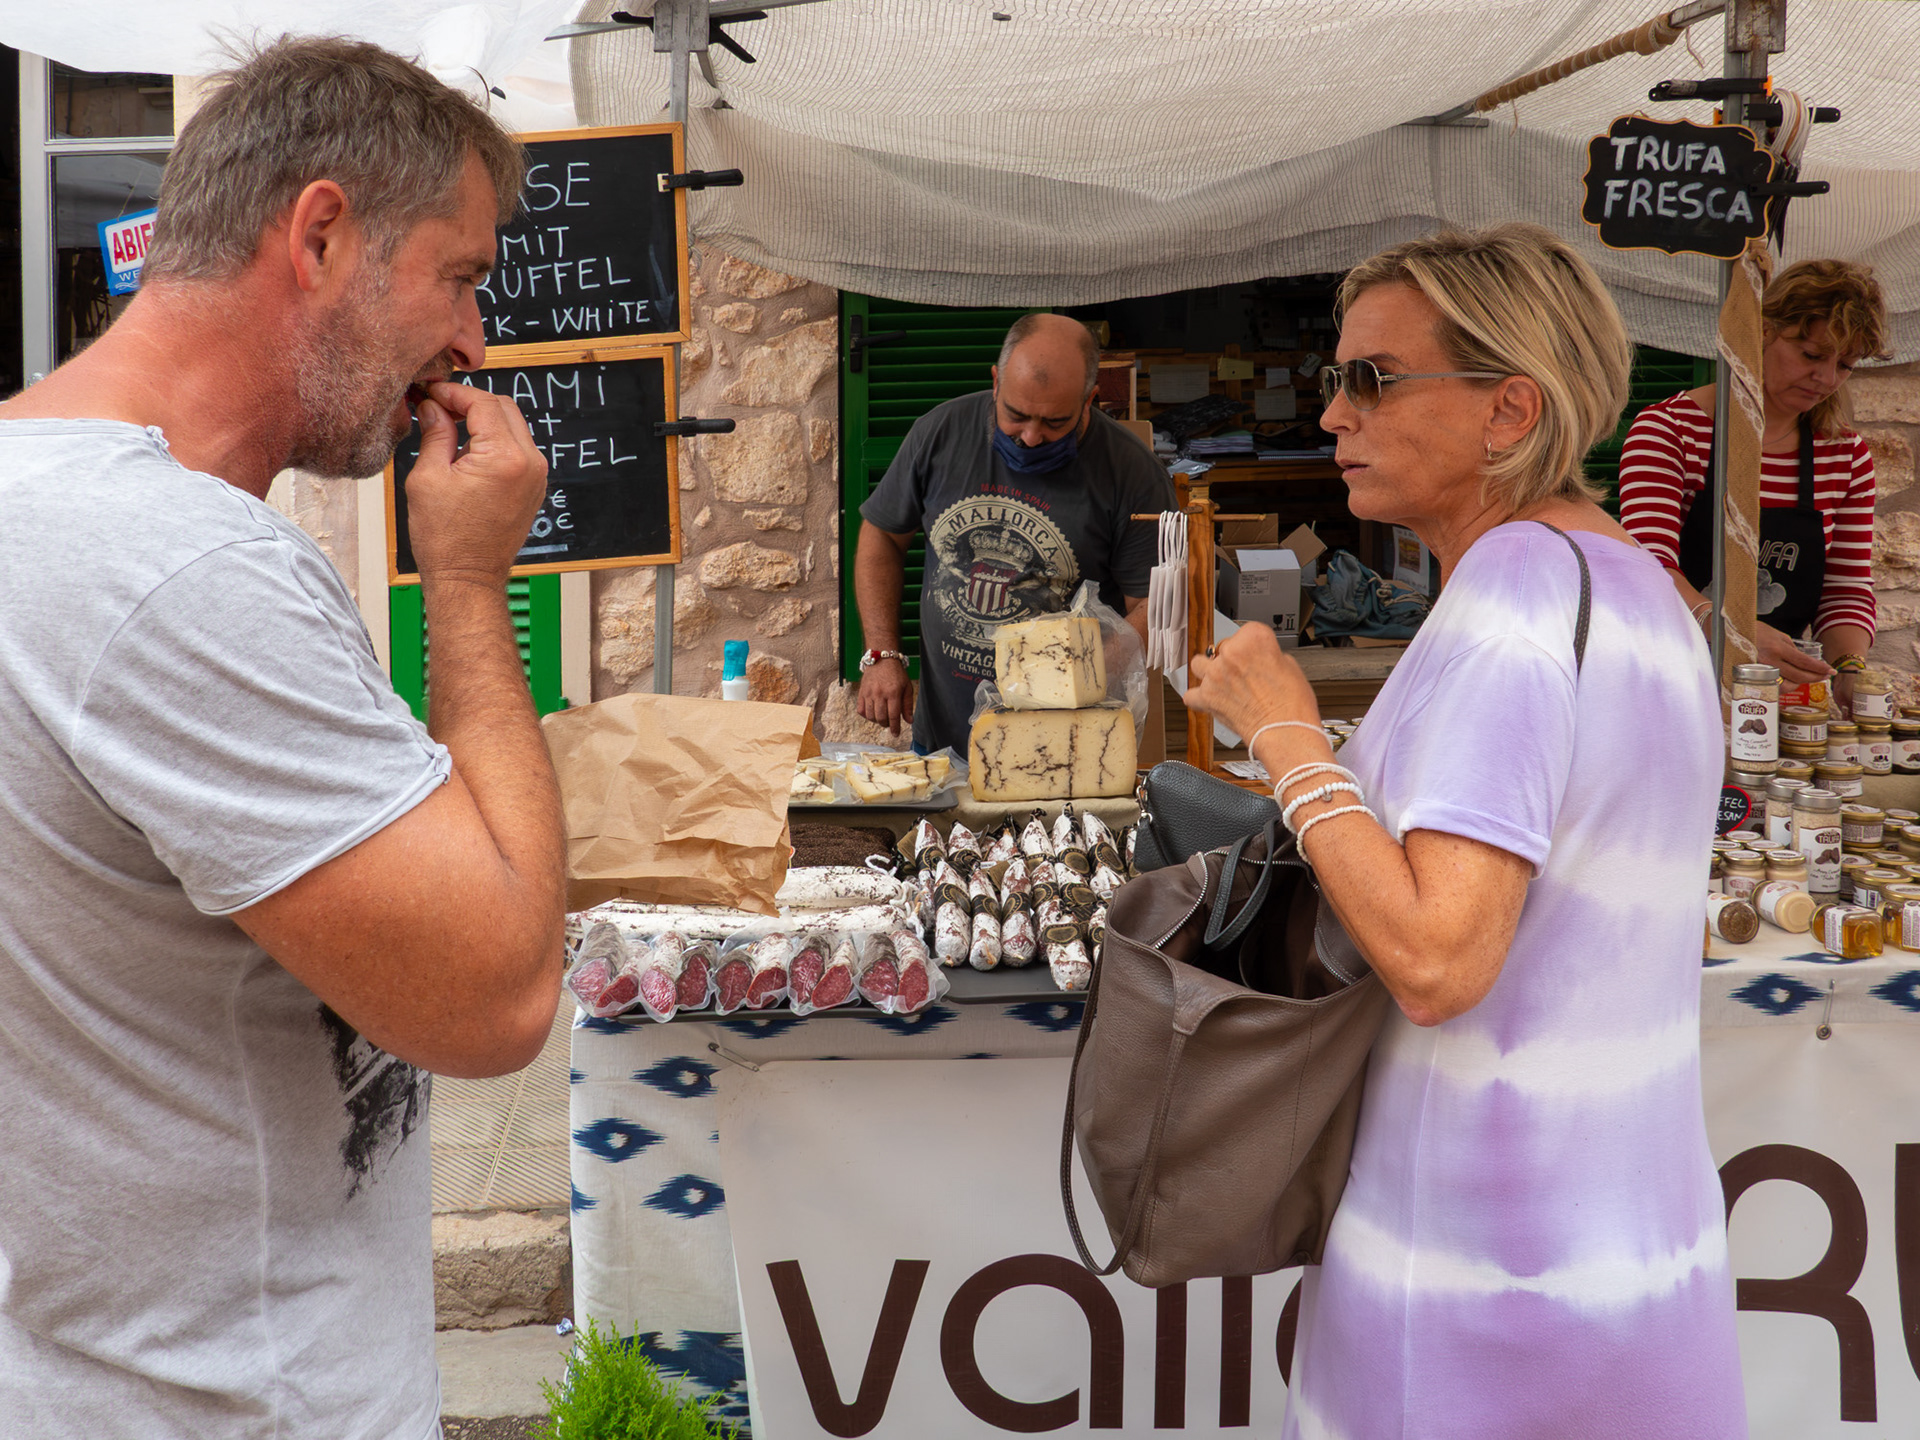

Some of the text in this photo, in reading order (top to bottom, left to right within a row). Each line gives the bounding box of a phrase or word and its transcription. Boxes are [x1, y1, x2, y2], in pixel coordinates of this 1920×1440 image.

[1610, 136, 1726, 175] TRUFA
[1603, 178, 1754, 224] FRESCA
[980, 483, 1051, 511] MADE IN SPAIN
[948, 506, 1059, 559] MALLORCA
[940, 640, 996, 669] VINTAG
[765, 1252, 1304, 1439] vall
